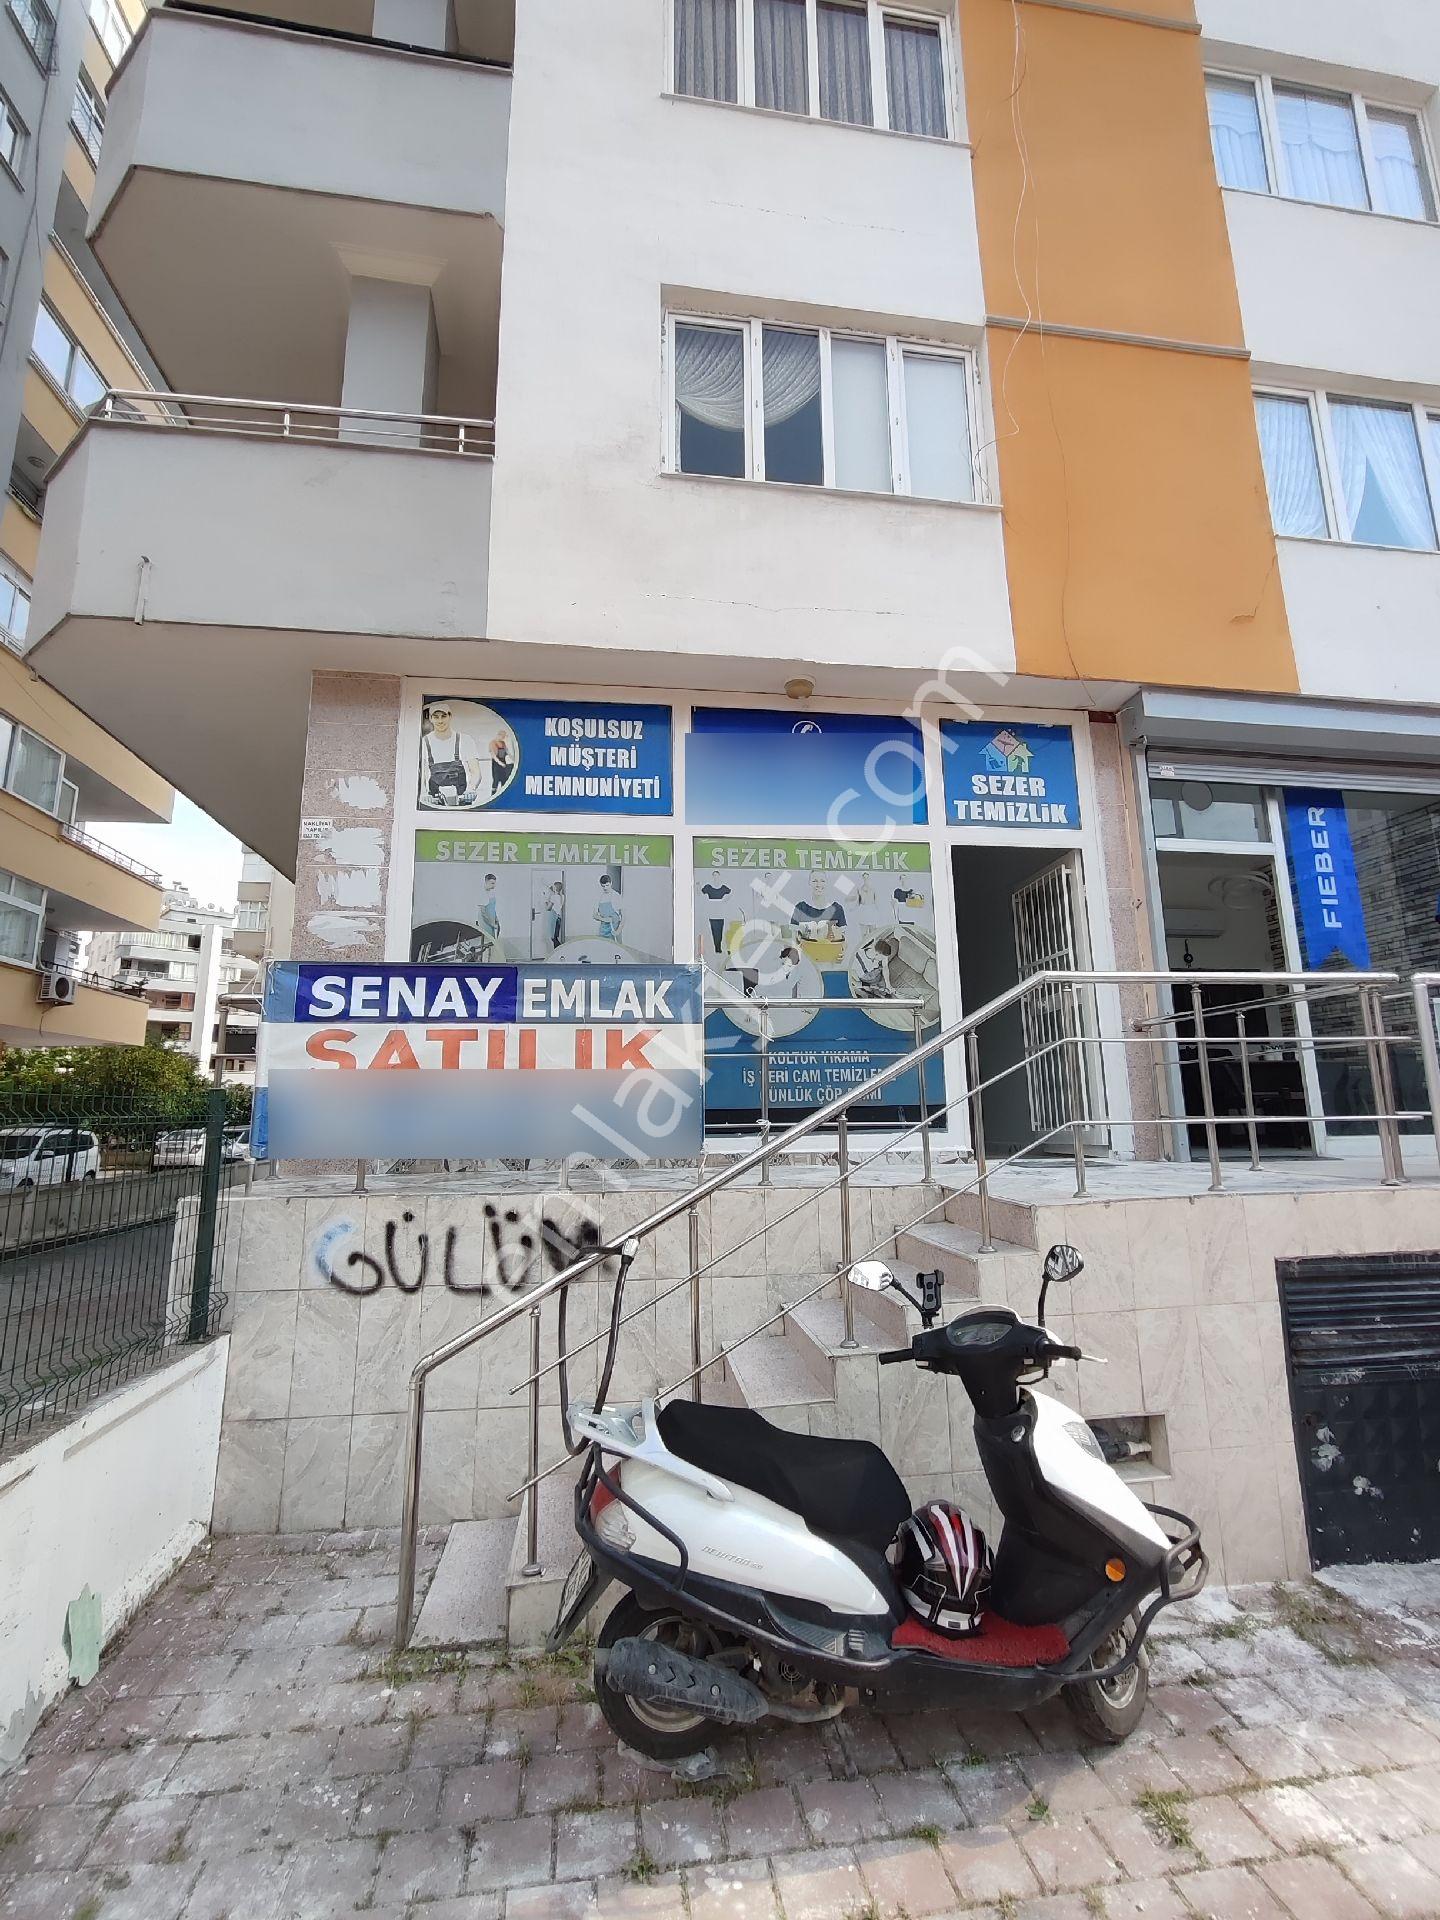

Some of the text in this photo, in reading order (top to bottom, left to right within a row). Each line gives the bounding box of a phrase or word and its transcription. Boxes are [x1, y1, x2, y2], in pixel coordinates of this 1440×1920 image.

[544, 716, 644, 742] KOŞULSUZ
[550, 745, 638, 771] MÜŞTERİ
[524, 774, 661, 799] MEMNUNİYETİ
[971, 774, 1046, 797] SEZER
[435, 840, 519, 863] SEZER
[711, 846, 788, 869] SEZER
[1307, 805, 1343, 929] FIEBER
[308, 976, 675, 1020] SENAY EMLAK
[759, 1068, 789, 1083] ERİ
[792, 1068, 821, 1083] CAM
[760, 1086, 813, 1103] ÜNLÜK
[816, 1085, 842, 1105] ÇÖP
